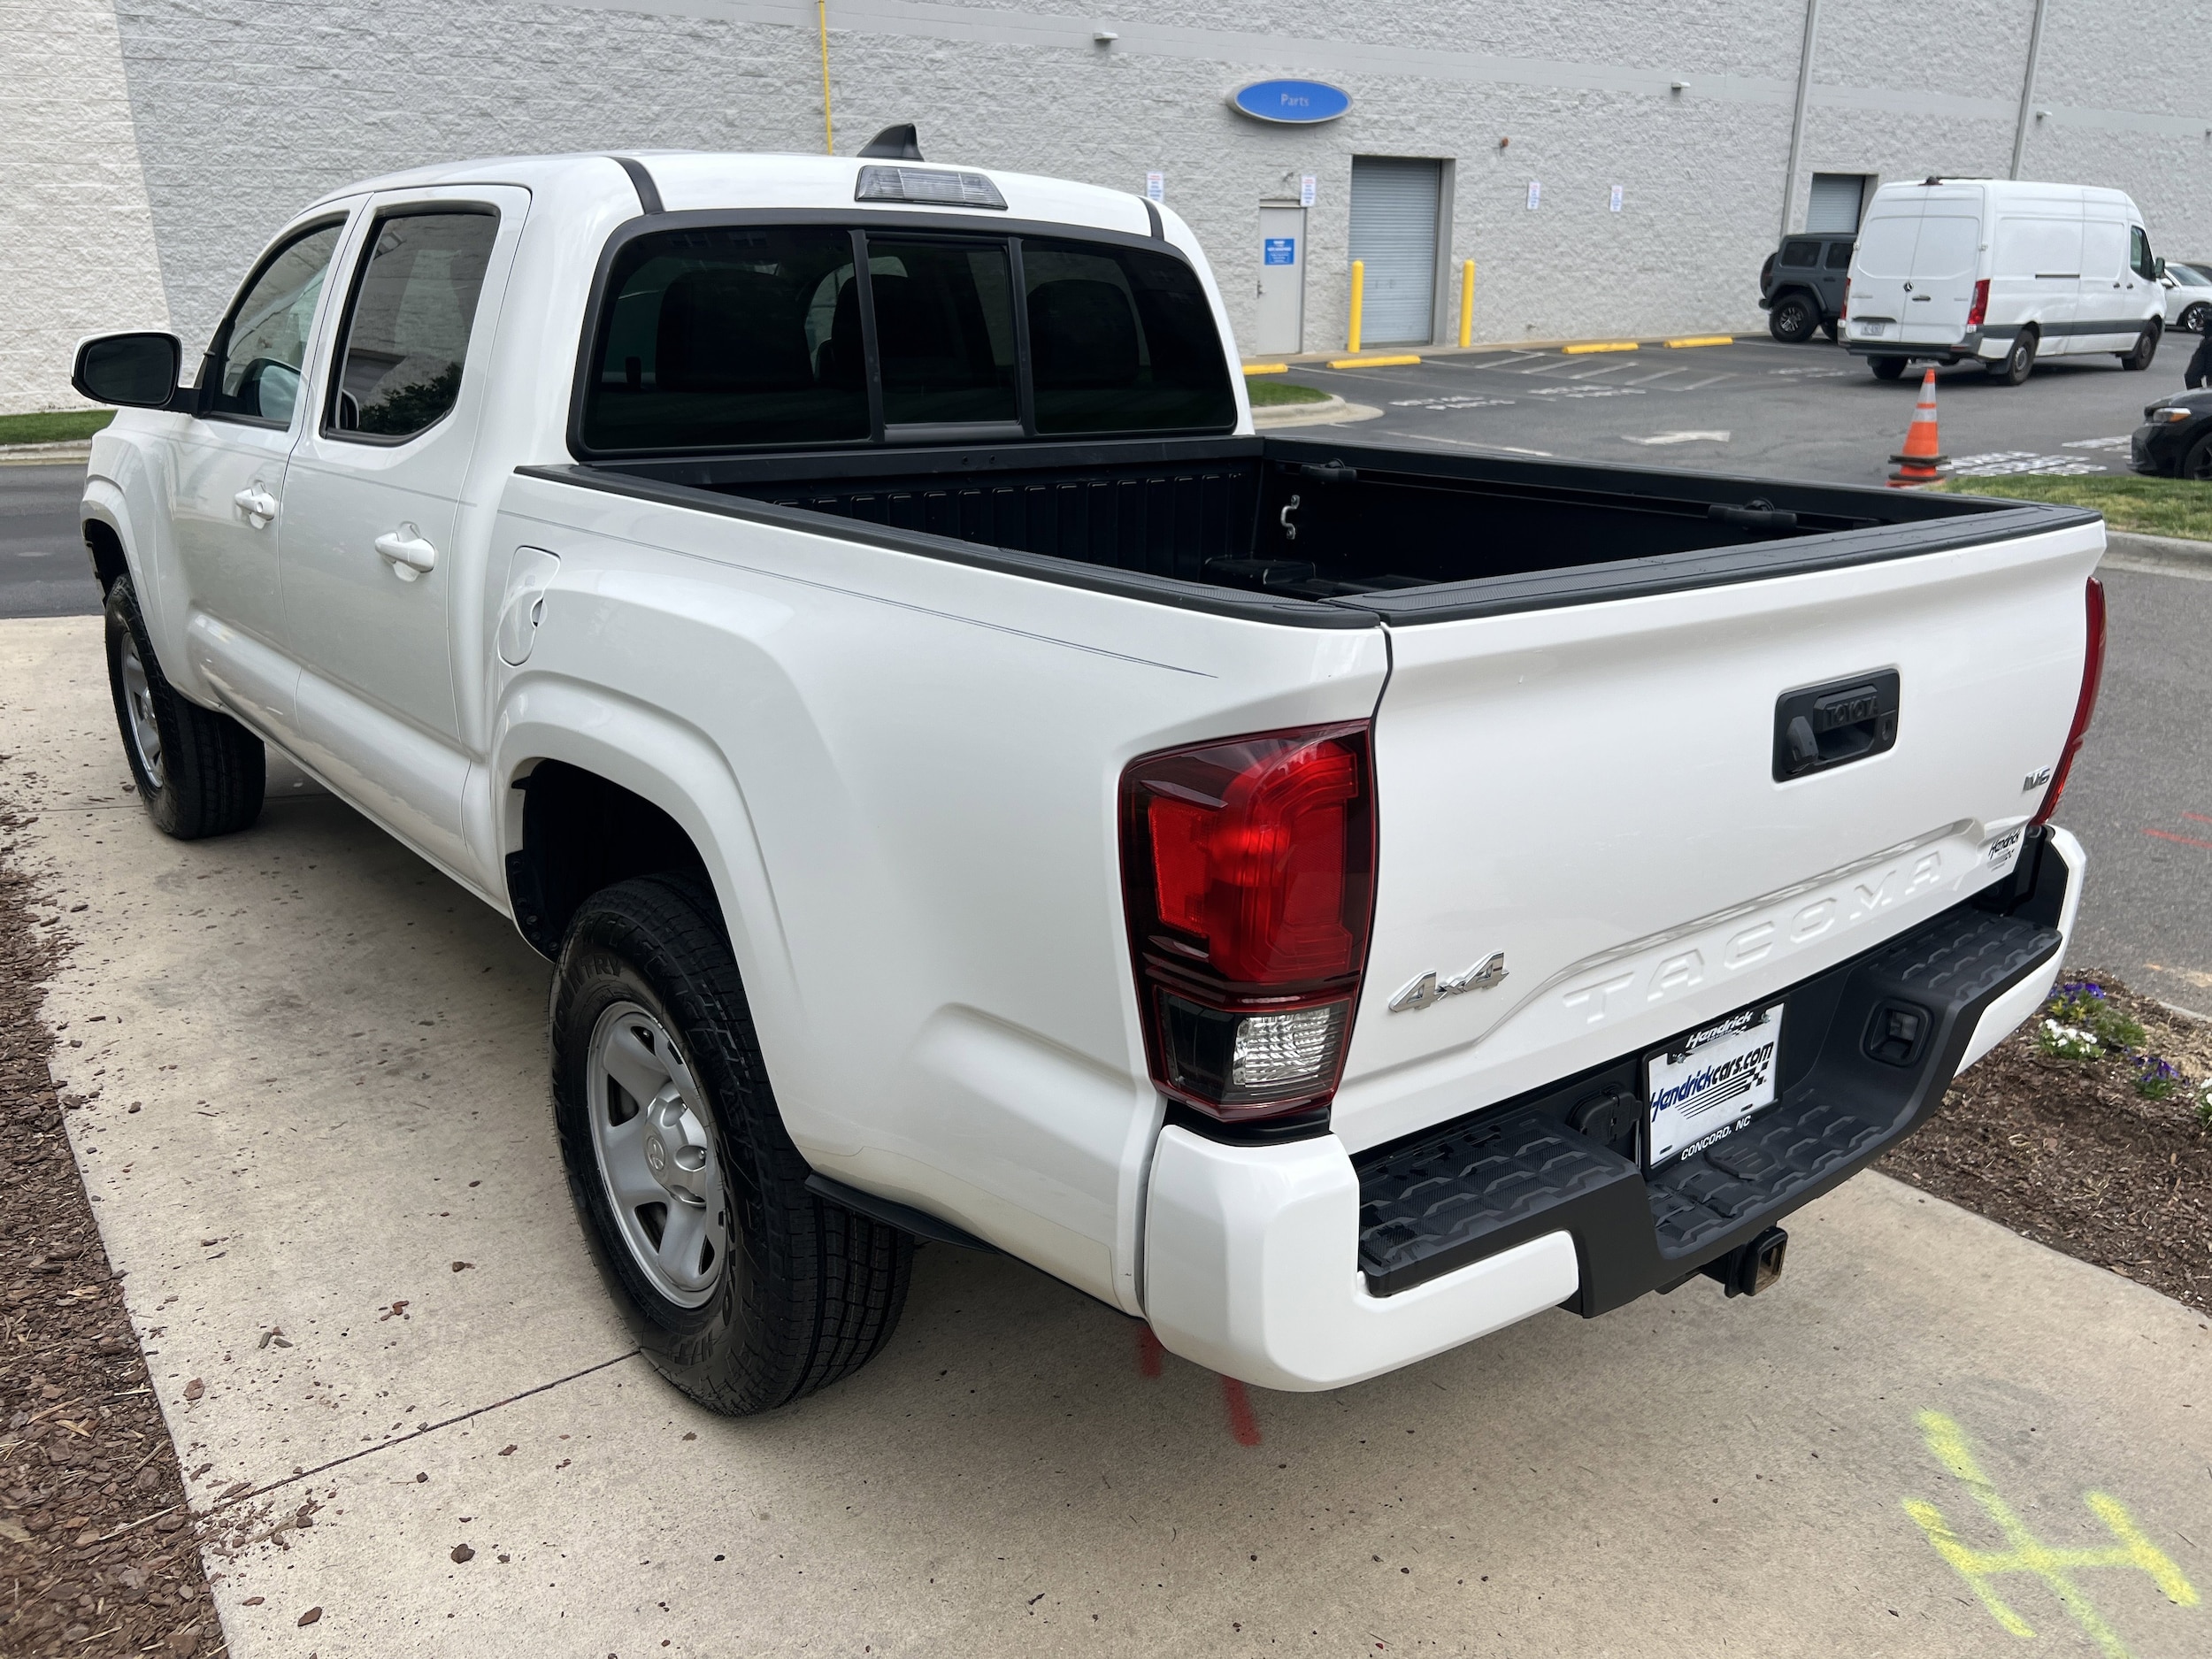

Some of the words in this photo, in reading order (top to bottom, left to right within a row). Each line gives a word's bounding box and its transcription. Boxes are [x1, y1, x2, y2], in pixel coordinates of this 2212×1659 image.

[1280, 93, 1310, 107] Parts
[1825, 695, 1878, 726] TOYOTA
[1563, 851, 1942, 1024] TACOMA
[1686, 1010, 1754, 1049] Hendrick
[1651, 1041, 1774, 1123] Hendrickcars.com
[1681, 1126, 1732, 1161] CONCORD,
[1735, 1115, 1752, 1132] NC
